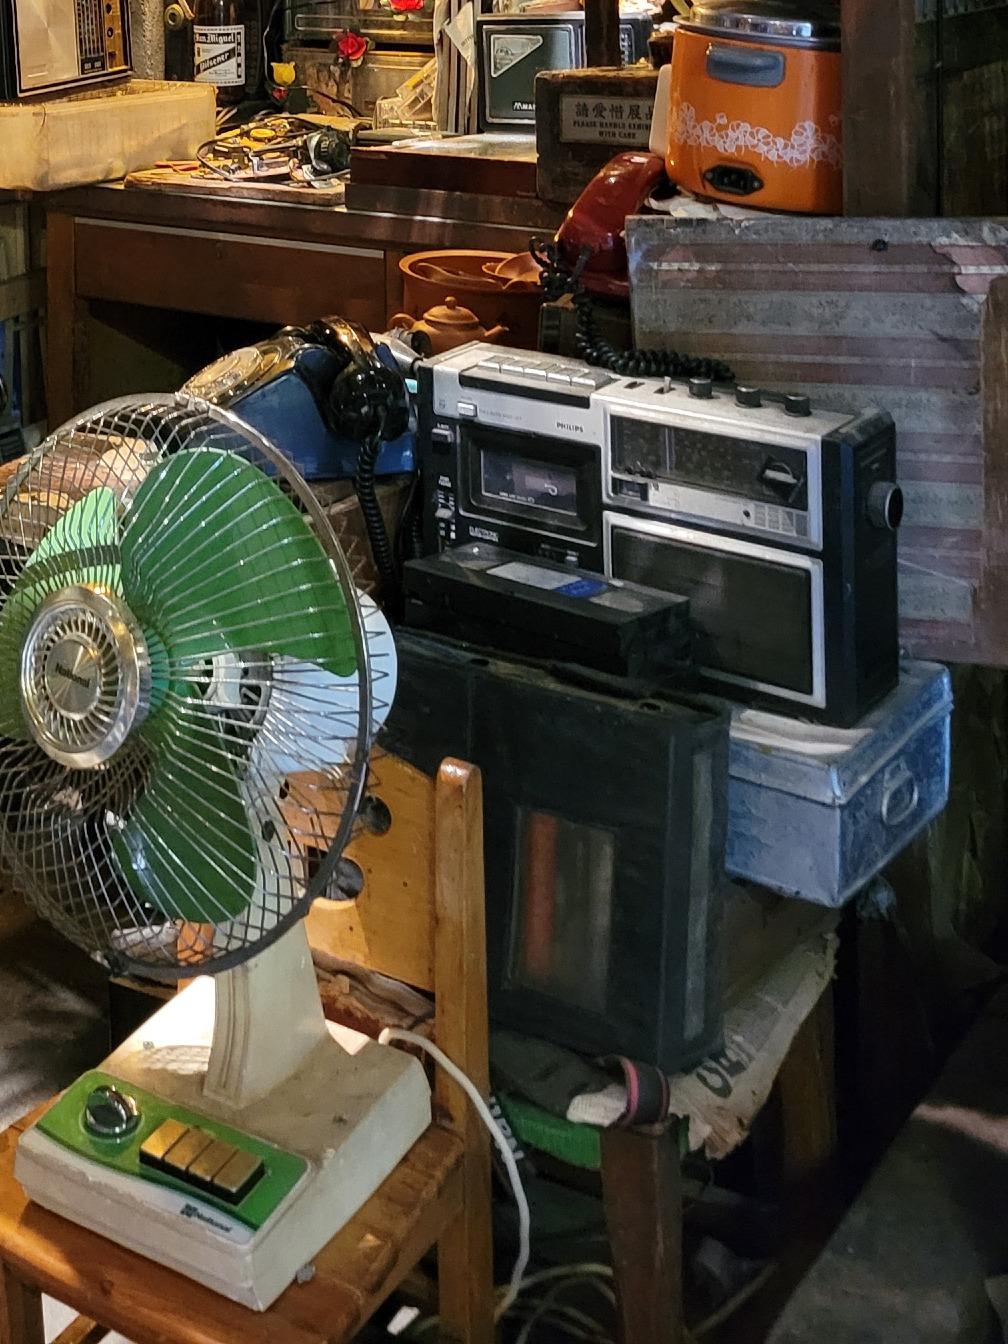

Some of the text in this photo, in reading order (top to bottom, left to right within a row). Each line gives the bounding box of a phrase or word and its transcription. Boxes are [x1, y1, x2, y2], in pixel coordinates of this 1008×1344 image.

[598, 131, 616, 139] WITH
[556, 421, 584, 433] PHILIPS
[54, 662, 91, 689] National
[196, 1210, 233, 1233] National
